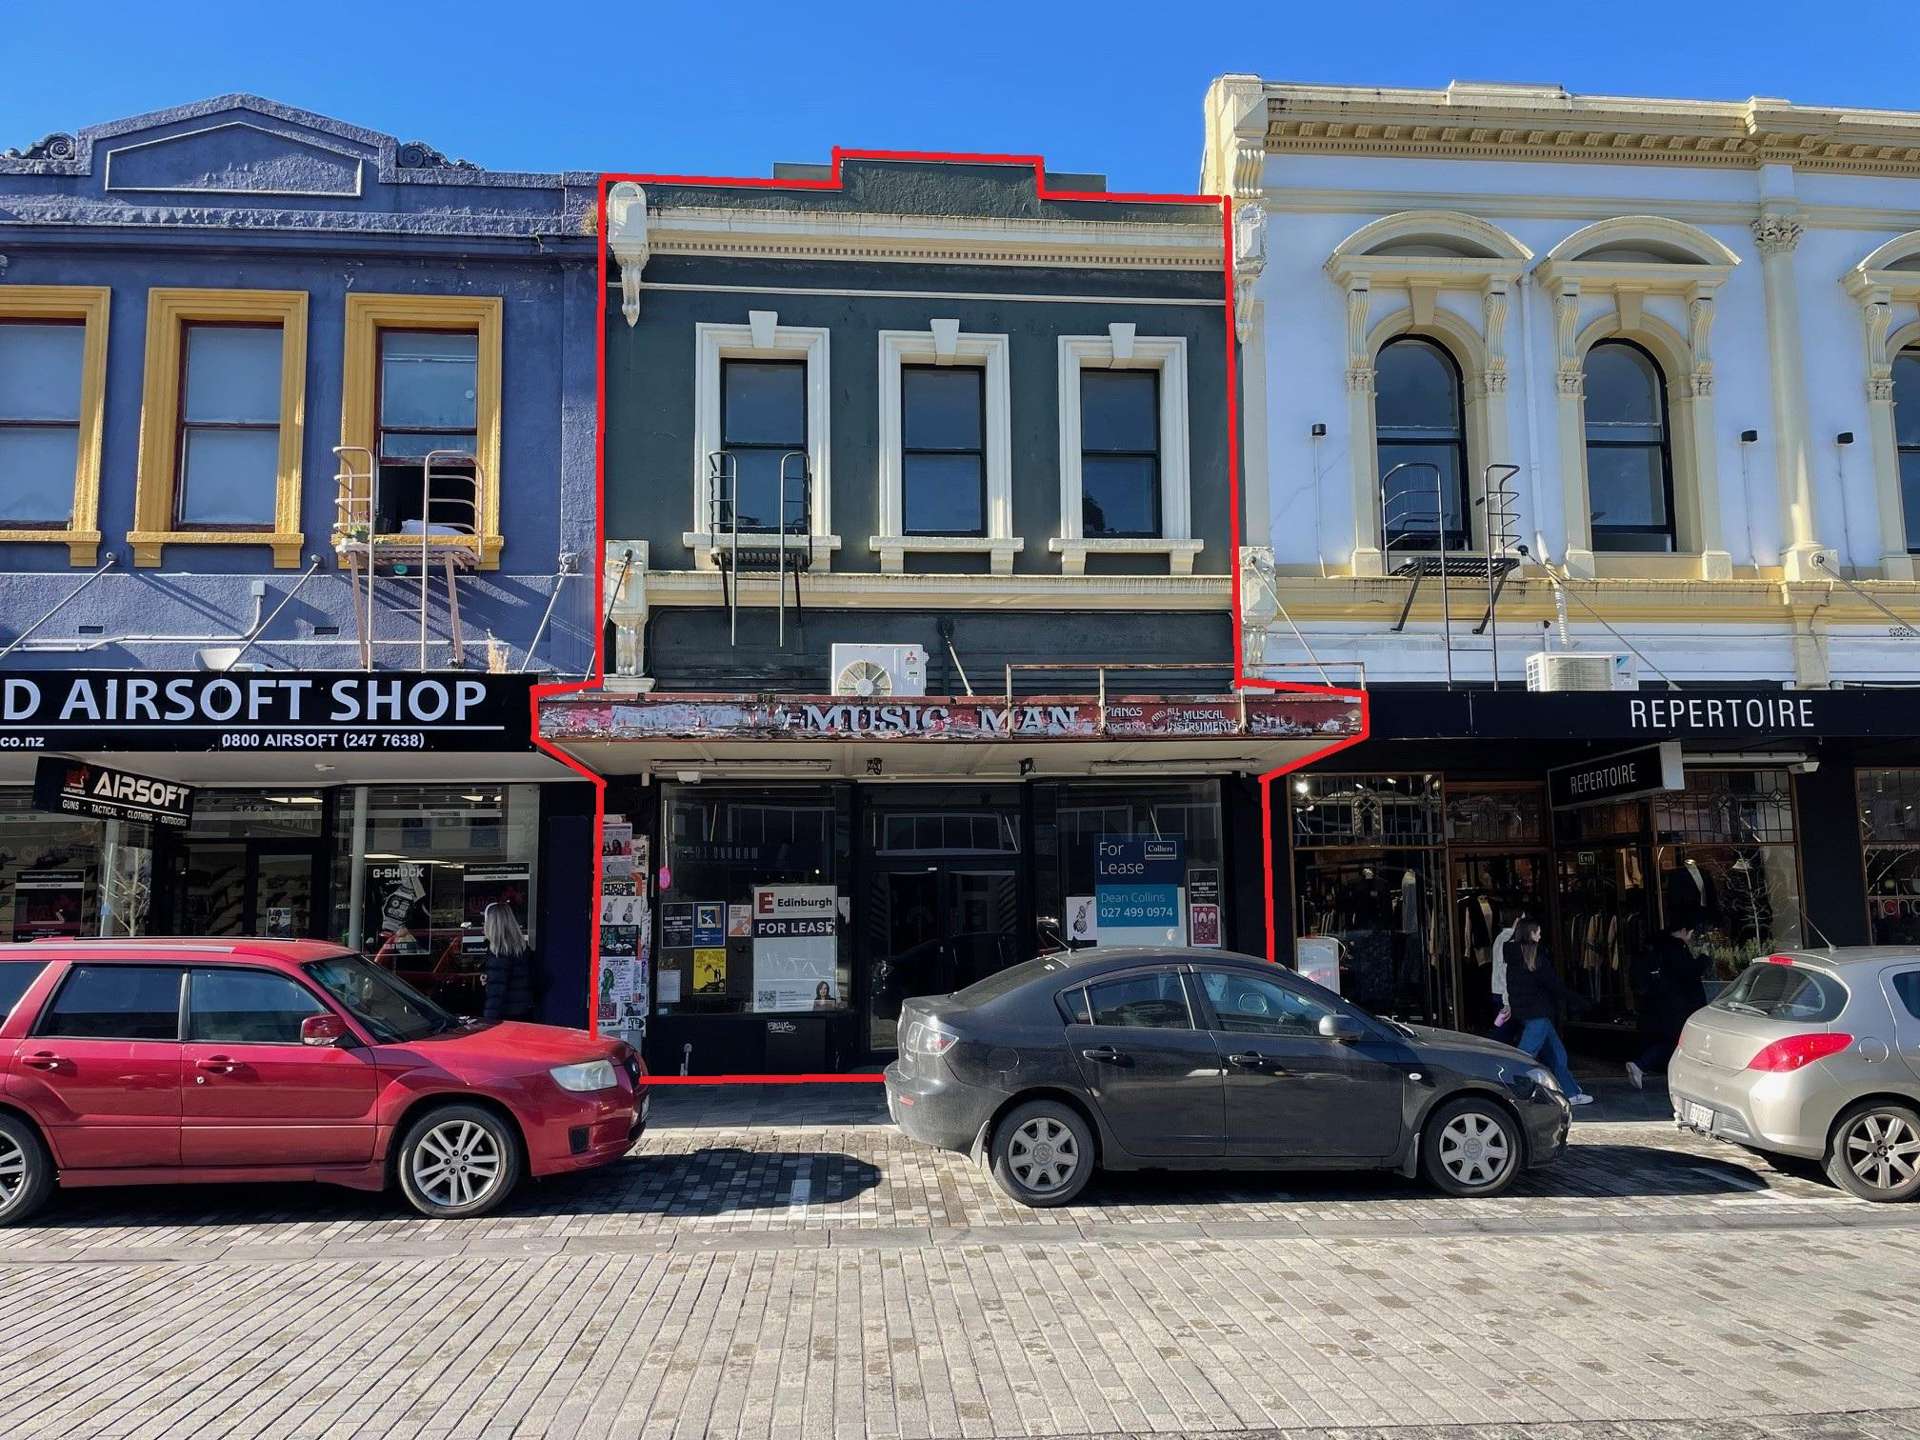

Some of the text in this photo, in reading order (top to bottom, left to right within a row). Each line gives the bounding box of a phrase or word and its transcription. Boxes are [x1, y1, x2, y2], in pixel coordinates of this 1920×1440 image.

[59, 678, 313, 721] AIRSOFT
[330, 679, 487, 722] SHOP
[802, 704, 953, 732] MUSIC
[976, 705, 1081, 733] MAN
[1104, 705, 1143, 718] PIANOS
[1183, 709, 1226, 721] MUSICAL
[1629, 698, 1815, 728] REPERTOIRE
[1167, 719, 1239, 733] INSTRUMENTS
[222, 732, 425, 748] 0800 AIRSOFT (247 7638)
[1570, 762, 1637, 795] REPERTOIRE
[93, 771, 190, 810] AIRSOFT
[62, 799, 80, 811] GUNS
[91, 803, 118, 817] TACTICAL
[127, 809, 153, 822] CLOTHING
[1099, 841, 1125, 857] For
[1147, 844, 1174, 853] Colliers
[372, 867, 425, 880] G-SHOCK
[1099, 860, 1145, 875] Lease
[777, 897, 833, 909] Edinburgh
[1101, 892, 1166, 903] Dean Collins
[1101, 907, 1173, 918] 027 499 0974
[758, 921, 834, 934] FOR LEASE
